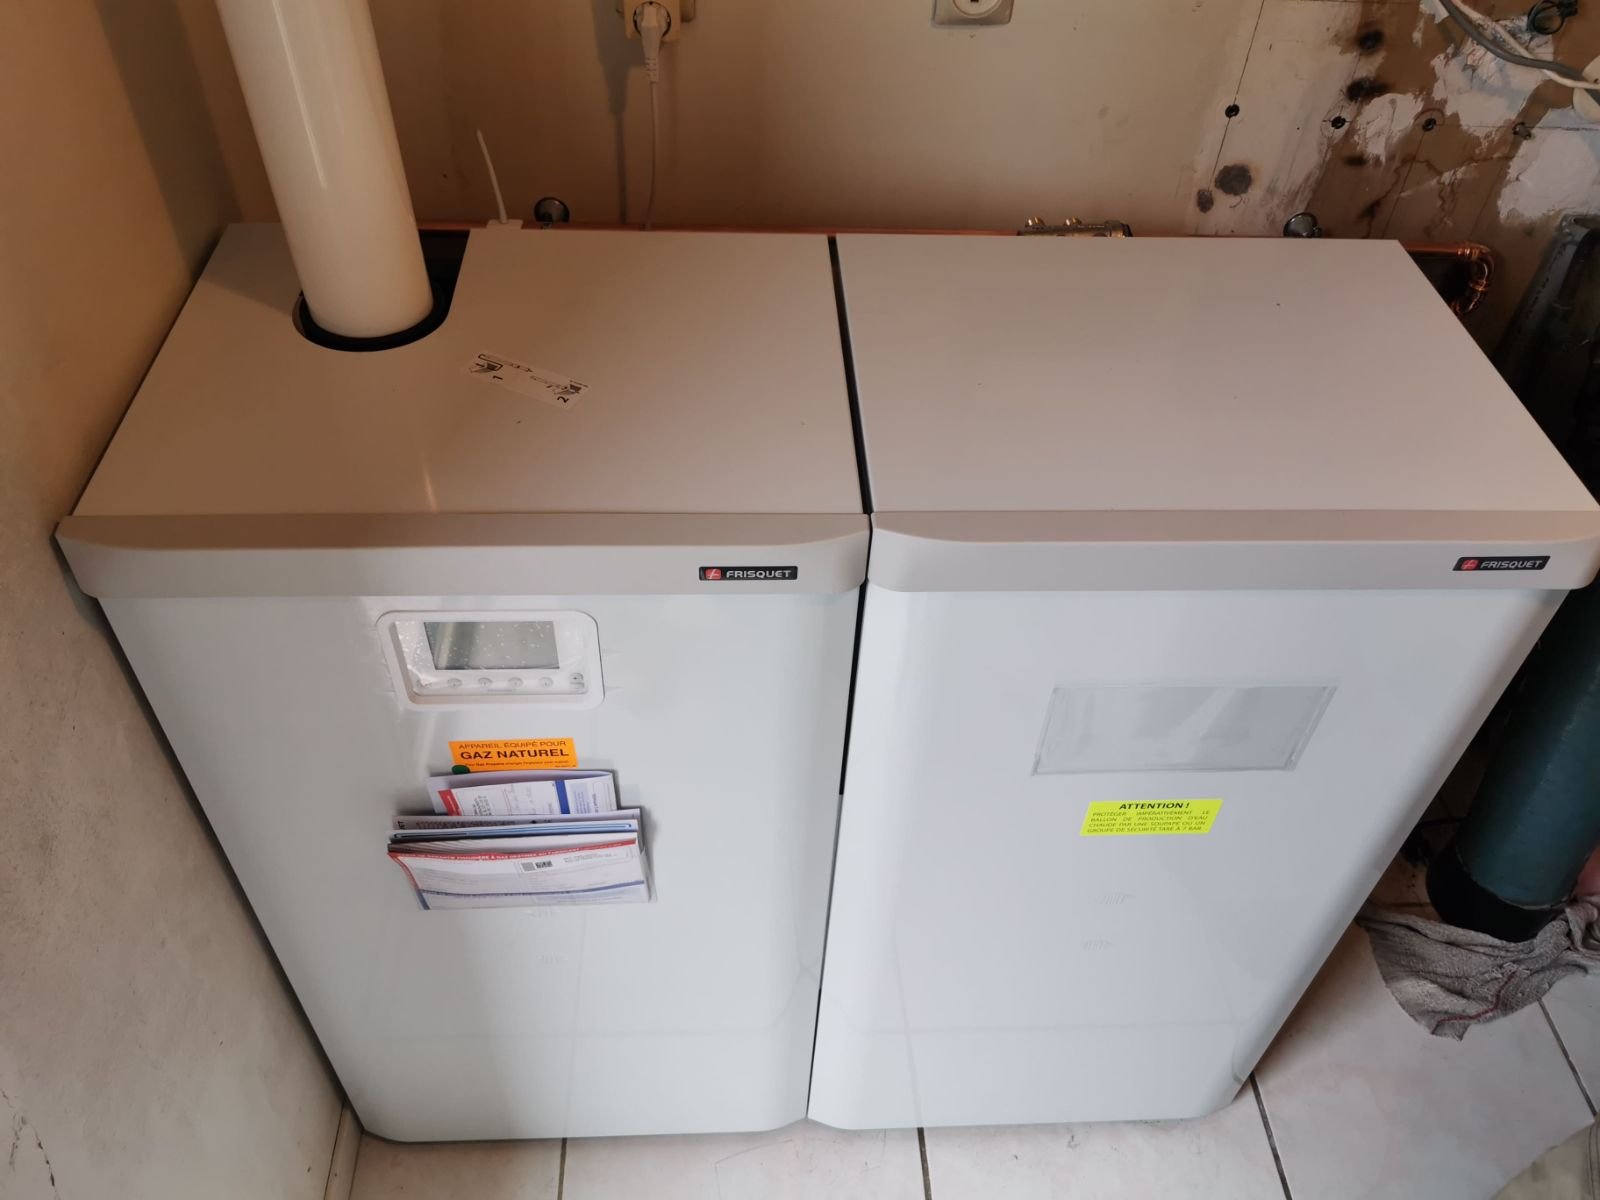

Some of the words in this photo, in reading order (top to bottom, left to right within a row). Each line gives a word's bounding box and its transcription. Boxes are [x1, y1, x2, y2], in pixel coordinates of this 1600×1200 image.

[1480, 560, 1543, 569] FRISQUET
[726, 570, 792, 579] FRISQUET
[458, 742, 502, 750] APPAREIL
[503, 740, 538, 749] ÉQUIPÉ
[460, 751, 493, 760] GAZ
[497, 748, 569, 759] NATUREL
[1119, 802, 1184, 810] ATTENTION
